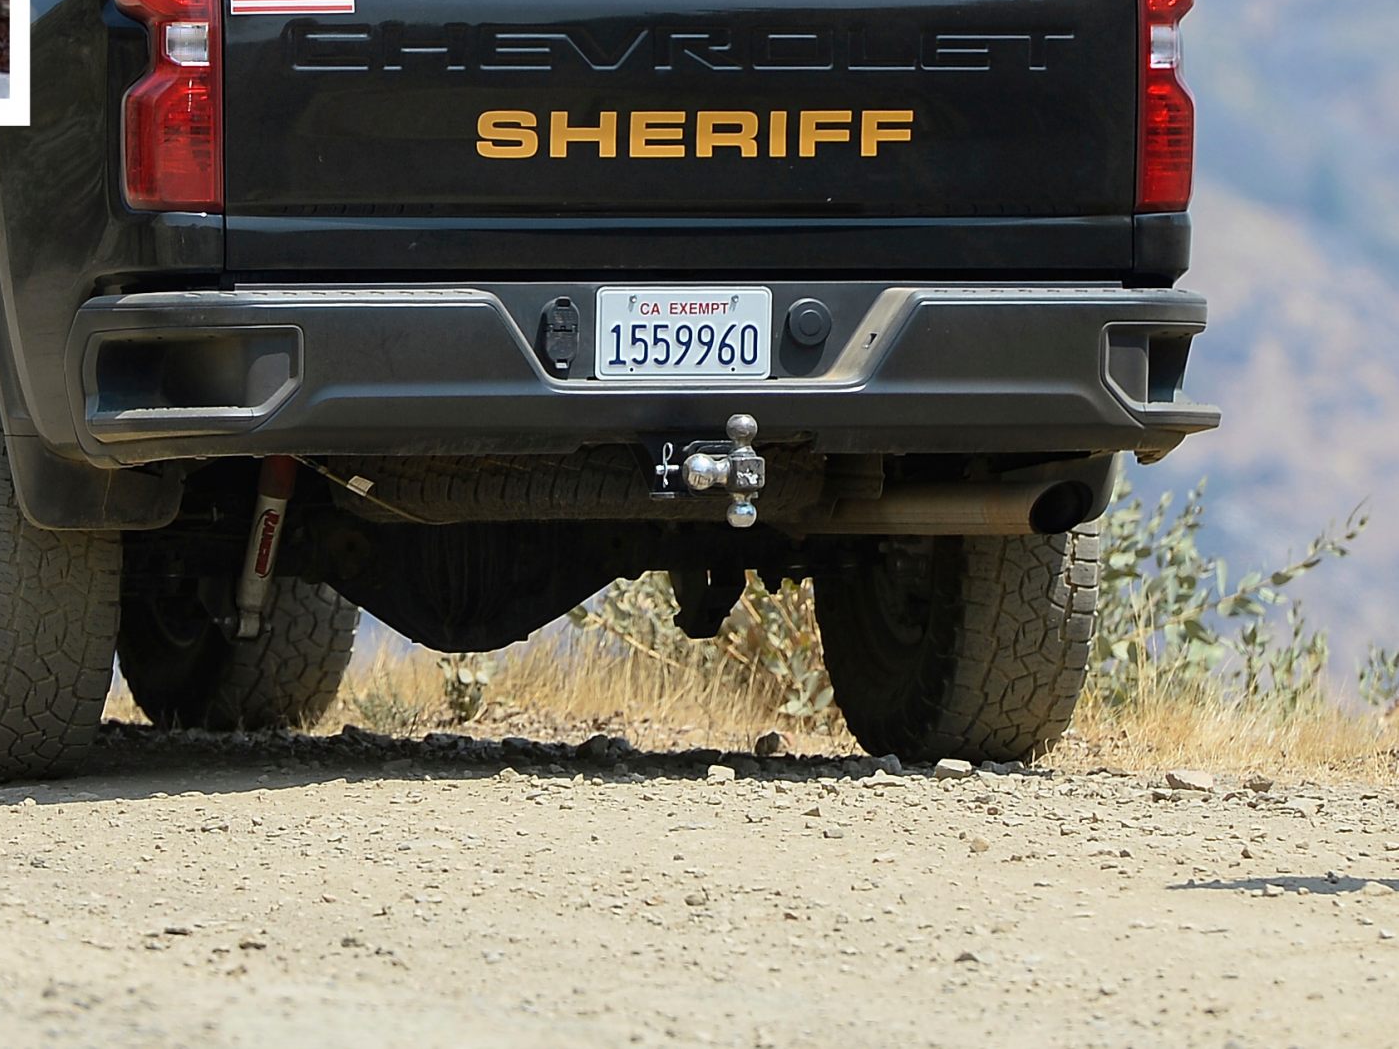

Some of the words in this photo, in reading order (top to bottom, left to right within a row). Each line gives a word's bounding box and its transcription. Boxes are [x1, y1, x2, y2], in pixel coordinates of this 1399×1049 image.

[284, 20, 1075, 70] CHEVROLET
[476, 110, 914, 158] SHERIFF
[640, 303, 660, 315] CA
[669, 303, 729, 314] EXEMPT
[608, 324, 758, 366] 1559960
